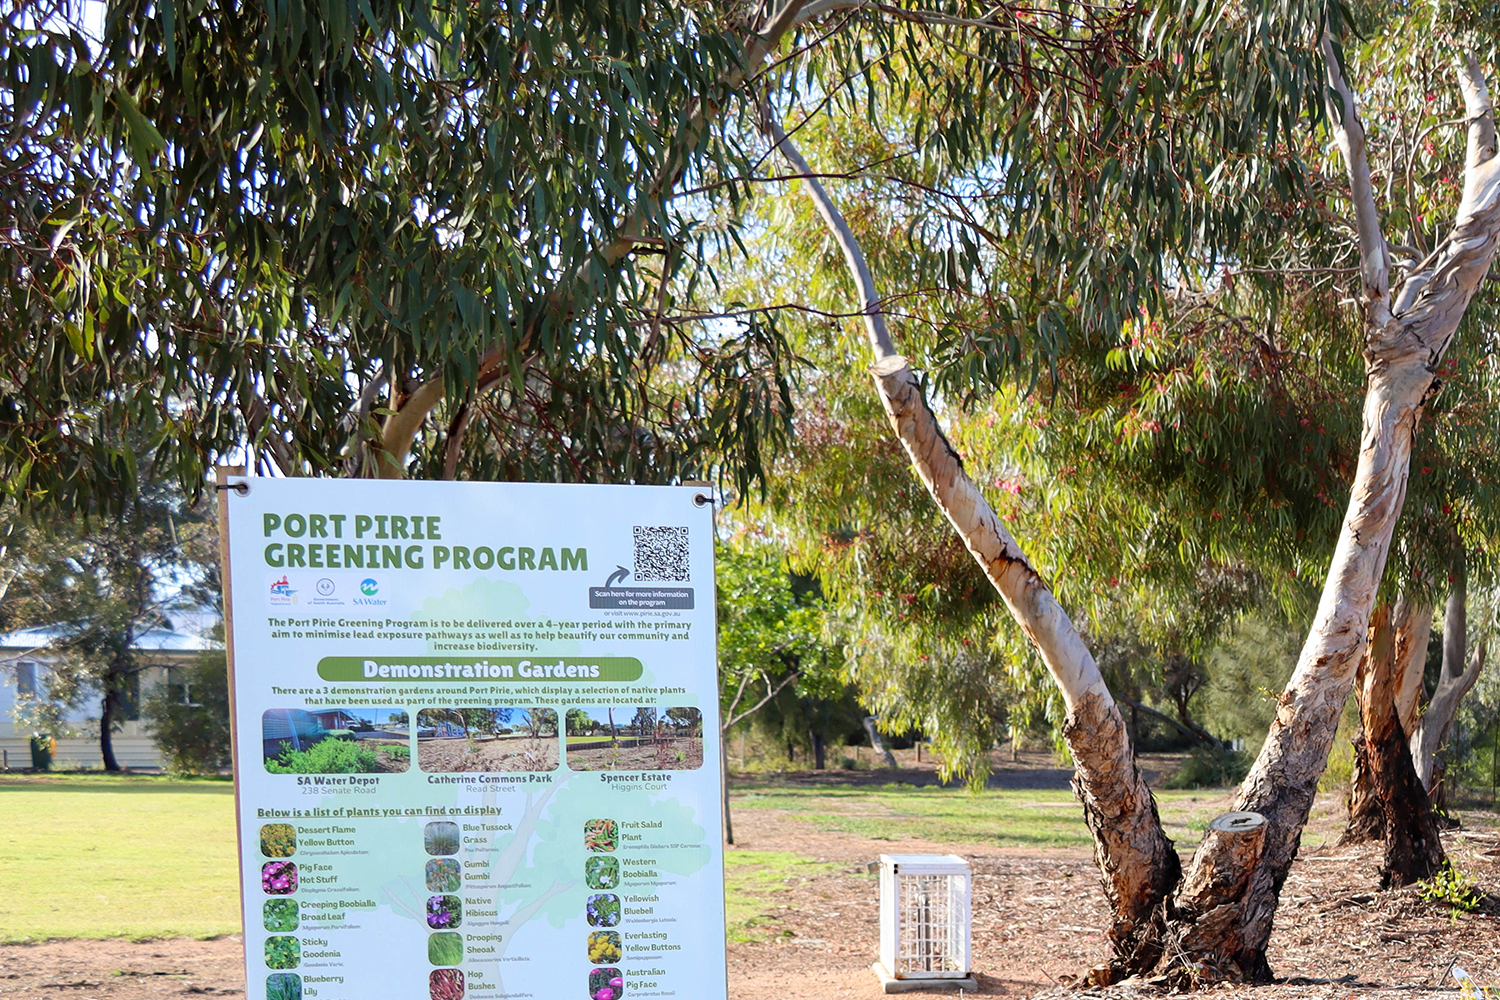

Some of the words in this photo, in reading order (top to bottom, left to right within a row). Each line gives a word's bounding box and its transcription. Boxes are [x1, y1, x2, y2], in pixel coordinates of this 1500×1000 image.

[263, 513, 346, 538] PORT
[355, 515, 441, 540] PIRIE
[264, 543, 424, 569] GREENING
[433, 546, 588, 571] PROGRAM
[268, 618, 286, 627] The
[288, 618, 310, 627] Port
[312, 618, 336, 627] Pirie
[338, 619, 383, 629] Greening
[386, 619, 428, 629] Program
[431, 619, 438, 627] is
[453, 619, 464, 628] be
[467, 619, 512, 628] delivered
[582, 620, 612, 630] period
[614, 620, 635, 629] with
[637, 620, 652, 629] the
[654, 620, 691, 630] primary
[271, 629, 290, 638] aim
[305, 630, 351, 638] minimise
[353, 630, 374, 639] lead
[377, 632, 423, 641] exposure
[425, 631, 473, 641] pathways
[488, 631, 508, 639] well
[535, 631, 555, 641] help
[558, 631, 597, 641] beautify
[618, 632, 669, 642] community
[671, 632, 689, 640] and
[434, 642, 475, 650] increase
[477, 642, 538, 652] biodiversity.
[364, 660, 513, 678] Demonstration
[518, 661, 600, 678] Gardens
[399, 687, 434, 696] gardens
[469, 686, 488, 694] Port
[490, 686, 513, 695] Pirie,
[515, 686, 539, 694] which
[541, 686, 573, 696] display
[582, 686, 619, 694] selection
[621, 686, 630, 694] of
[631, 686, 658, 694] native
[659, 686, 686, 695] plants
[406, 698, 425, 706] part
[454, 697, 492, 706] greening
[494, 698, 533, 706] program.
[535, 696, 559, 704] These
[561, 696, 595, 706] gardens
[613, 696, 643, 704] located
[297, 776, 311, 785] SA
[314, 776, 347, 785] Water
[349, 776, 379, 786] Depot
[428, 775, 476, 784] Catherine
[478, 775, 527, 783] Commons
[529, 774, 552, 783] Park
[601, 773, 639, 783] Spencer
[642, 773, 671, 781] Estate
[302, 787, 319, 795] 238
[321, 786, 352, 794] Senate
[354, 785, 376, 794] Road
[466, 785, 488, 793] Read
[611, 783, 642, 792] Higgins
[258, 808, 290, 817] Below
[293, 808, 302, 817] is
[313, 808, 330, 816] list
[333, 807, 344, 816] of
[346, 807, 380, 819] plants
[382, 809, 402, 819] you
[425, 806, 446, 815] find
[464, 805, 502, 818] display
[480, 823, 513, 831] Tussock
[641, 820, 662, 828] Salad
[298, 826, 331, 834] Dessert
[463, 836, 487, 844] Grass
[622, 833, 642, 841] Plant
[326, 838, 354, 846] Button
[299, 864, 312, 873] Pig
[464, 860, 489, 868] Gumbi
[464, 872, 490, 880] Gumbi
[623, 870, 658, 878] Boobialla
[300, 876, 315, 884] Hot
[623, 894, 659, 902] Yellowish
[300, 900, 338, 910] Creeping
[339, 900, 376, 908] Boobialla
[466, 909, 498, 917] Hibiscus
[624, 907, 653, 915] Bluebell
[301, 913, 326, 921] Broad
[328, 912, 346, 920] Leaf
[466, 933, 502, 943] Drooping
[625, 931, 667, 940] Everlasting
[302, 938, 328, 947] Sticky
[303, 950, 341, 958] Goodenia
[467, 946, 495, 954] Sheoak
[468, 971, 483, 979] Hop
[626, 968, 665, 976] Australian
[303, 975, 344, 984] Blueberry
[468, 982, 496, 990] Bushes
[626, 981, 638, 990] Pig
[304, 987, 318, 997] Lily
